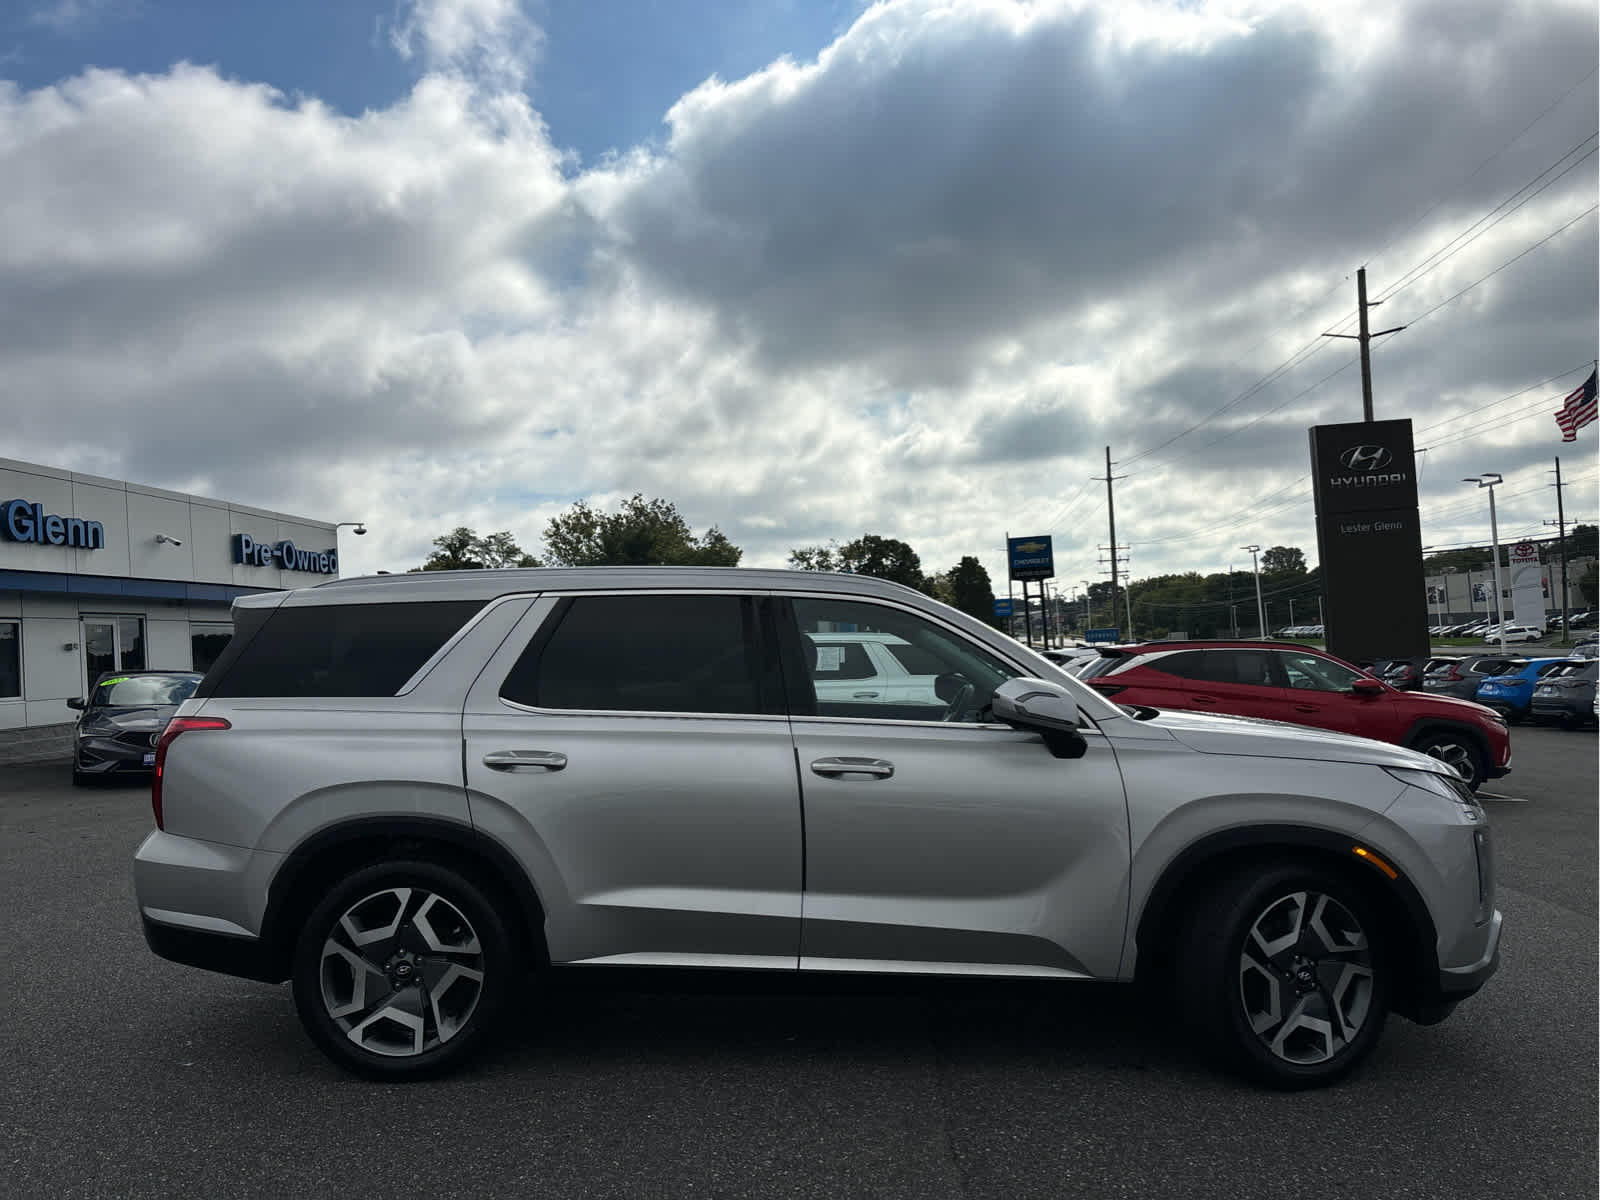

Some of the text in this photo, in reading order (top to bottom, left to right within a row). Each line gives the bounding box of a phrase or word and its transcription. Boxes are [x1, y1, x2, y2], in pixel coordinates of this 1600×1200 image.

[1329, 473, 1407, 489] HYUNDAI
[5, 498, 105, 549] Glenn
[1340, 520, 1403, 534] Lester Glenn
[234, 533, 338, 575] Pre-Owned
